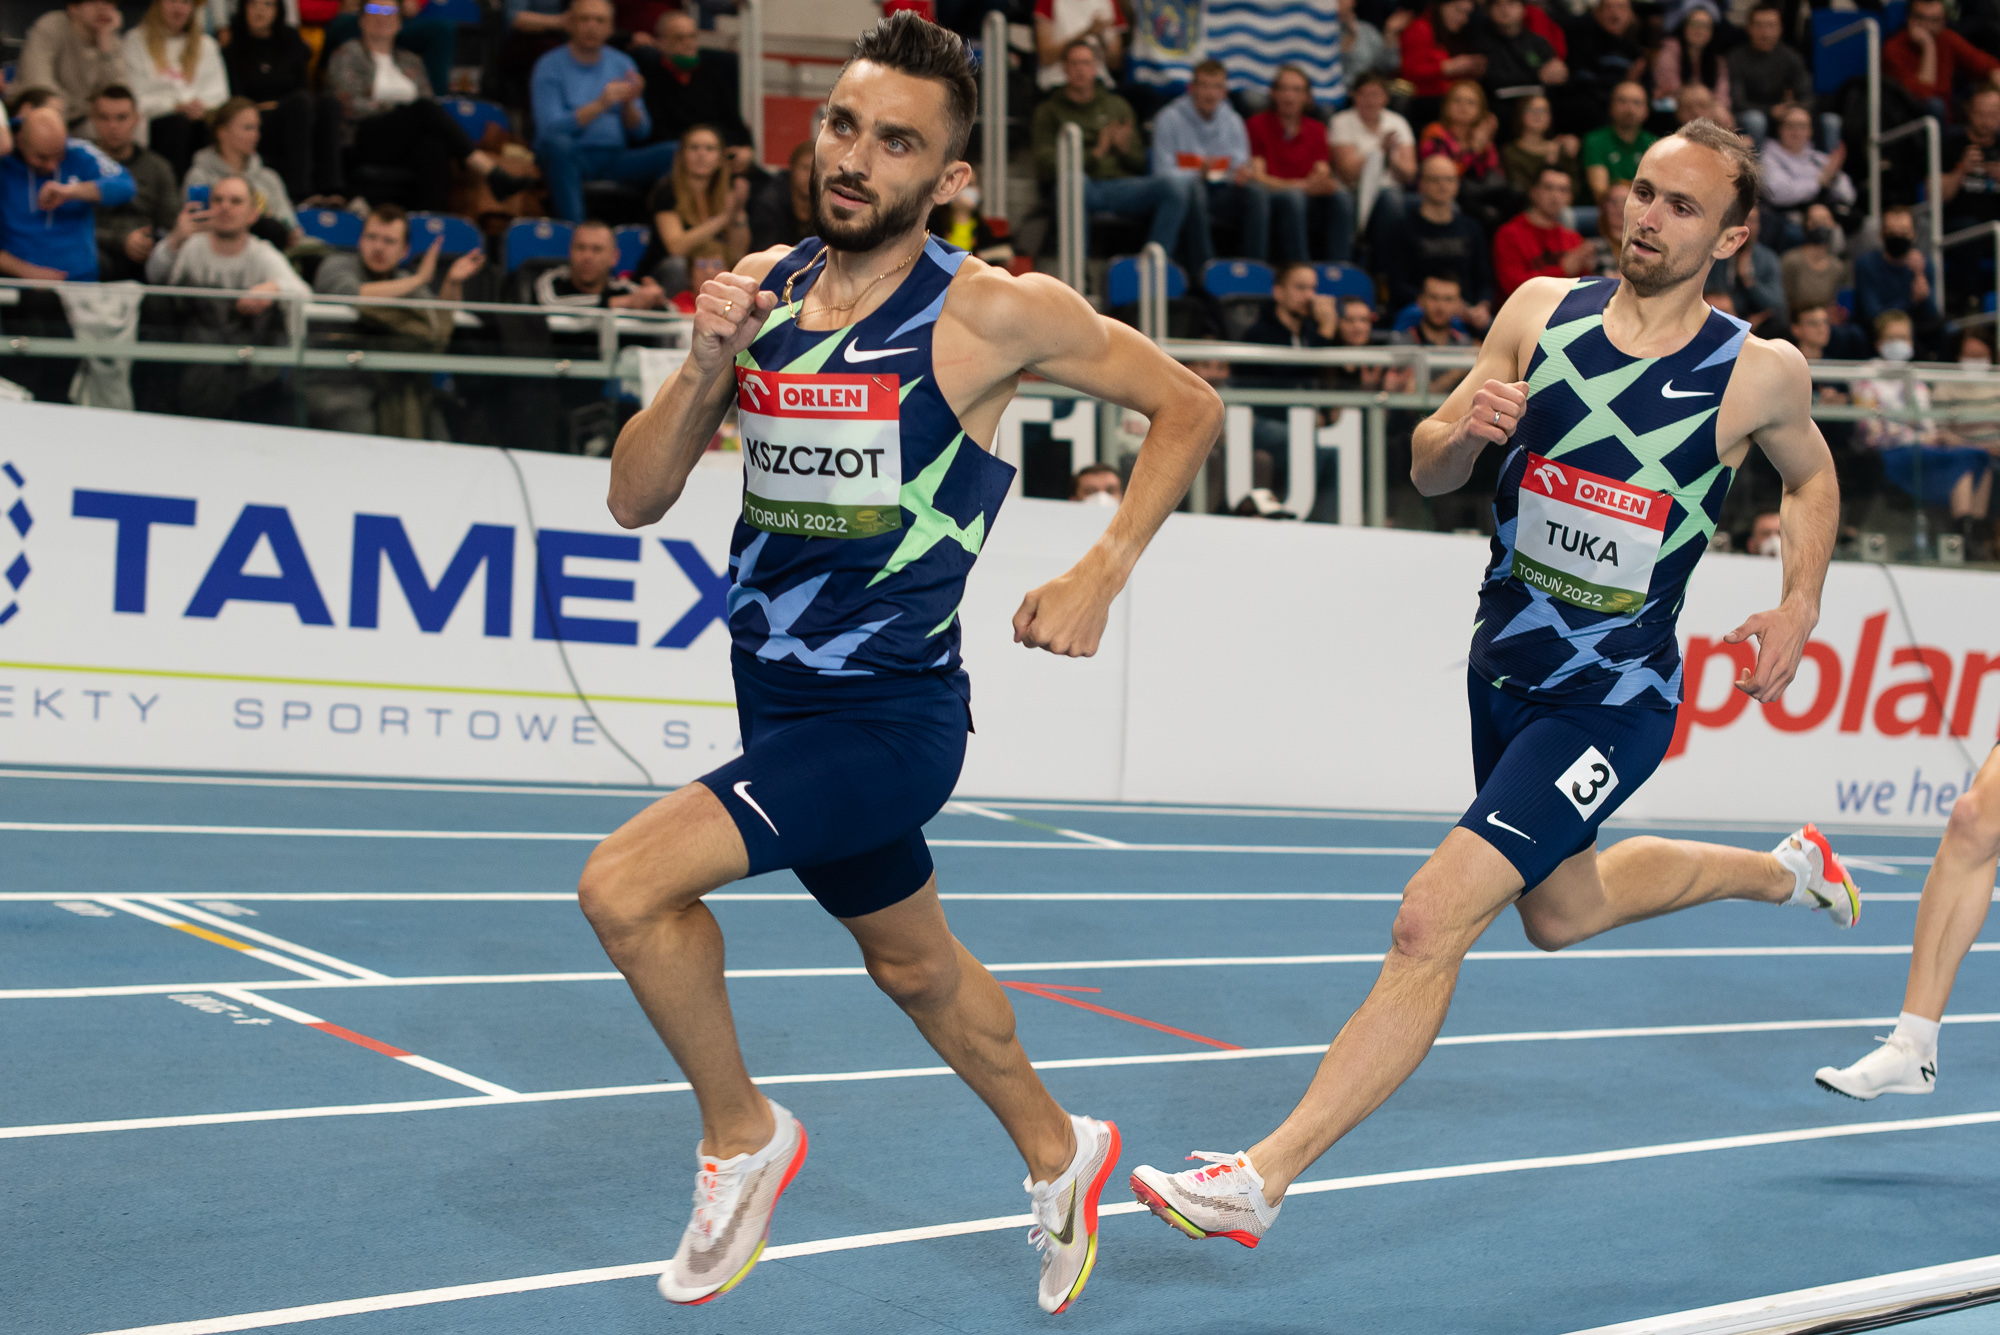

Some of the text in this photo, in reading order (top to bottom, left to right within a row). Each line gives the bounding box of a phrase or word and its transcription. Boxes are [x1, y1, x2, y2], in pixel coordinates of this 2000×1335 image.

[783, 387, 862, 408] ORLEN
[746, 437, 885, 479] KSZCZOT
[750, 508, 799, 529] TORUŃ
[803, 513, 848, 533] 2022
[1579, 483, 1646, 515] ORLEN
[1546, 519, 1619, 567] TUKA
[72, 488, 732, 650] TAMEX
[1518, 562, 1604, 607] TORUŃ 2022
[233, 697, 597, 746] SPORTOWE
[663, 719, 742, 751] S.
[1571, 762, 1610, 806] 3
[1836, 779, 1896, 815] we
